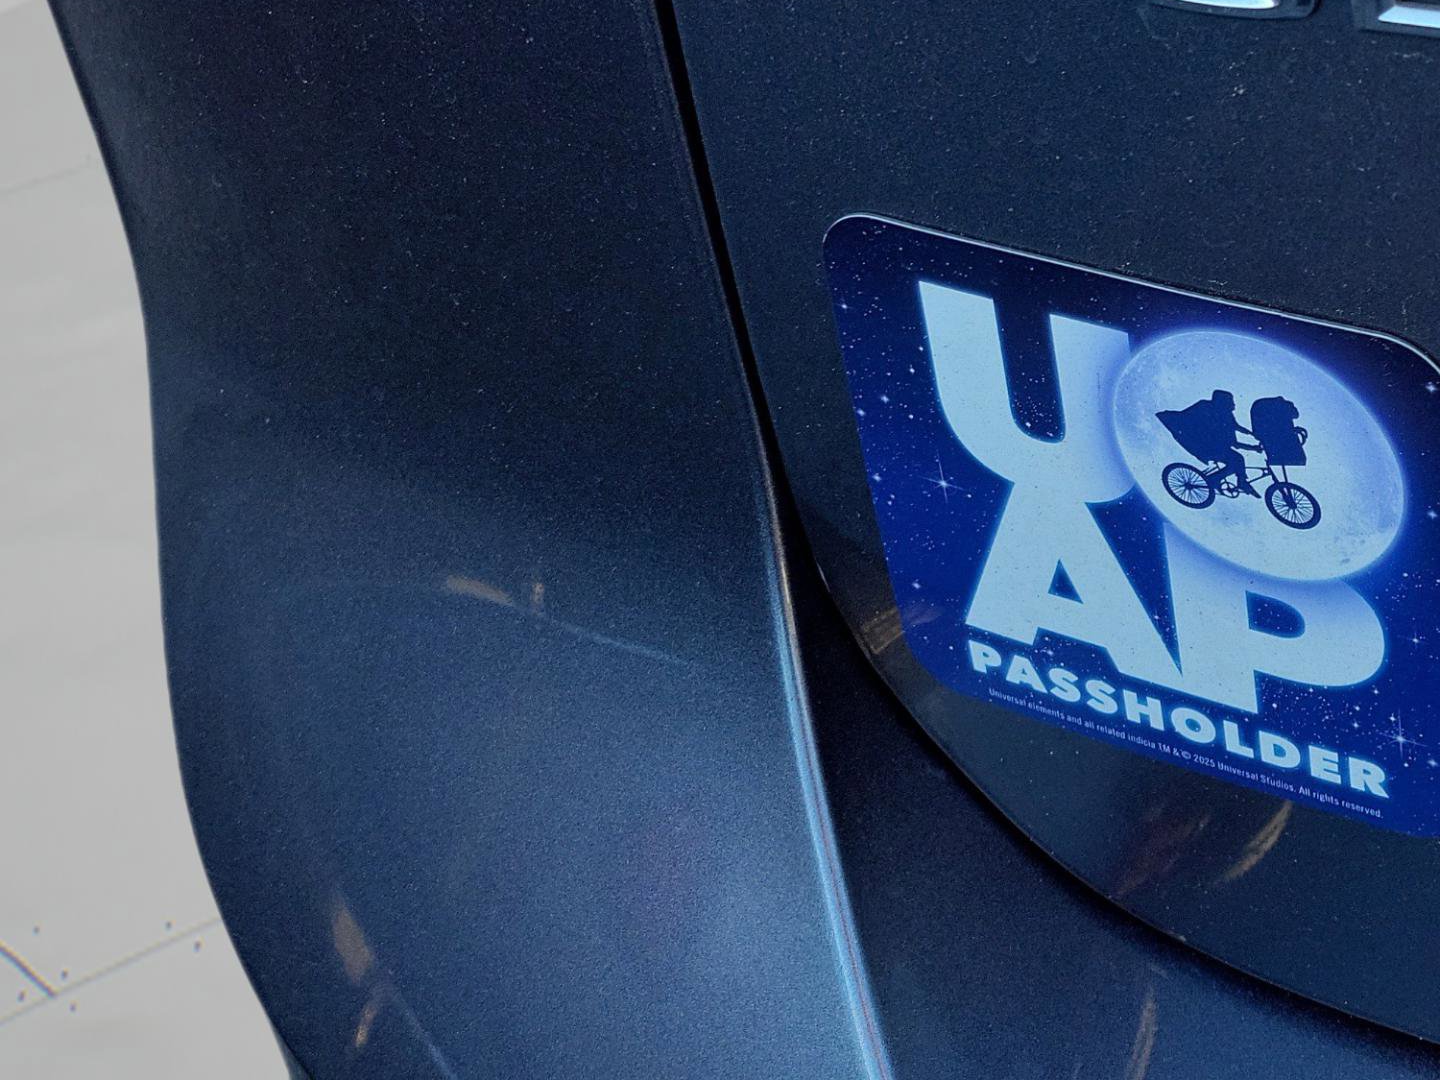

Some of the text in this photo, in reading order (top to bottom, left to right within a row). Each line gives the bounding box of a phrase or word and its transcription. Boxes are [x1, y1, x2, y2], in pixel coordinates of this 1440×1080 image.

[967, 639, 1390, 799] PASSHOLDER
[989, 687, 1027, 707] Universal
[1028, 701, 1065, 721] elements
[1066, 714, 1082, 727] and
[1084, 719, 1095, 730] all
[1096, 723, 1126, 740] related
[1193, 753, 1216, 769] 2025
[1217, 761, 1259, 781] Universal
[1260, 774, 1297, 793] Studios.
[1299, 785, 1311, 797] All
[1312, 791, 1339, 807] rights
[1341, 800, 1384, 819] reserved.
